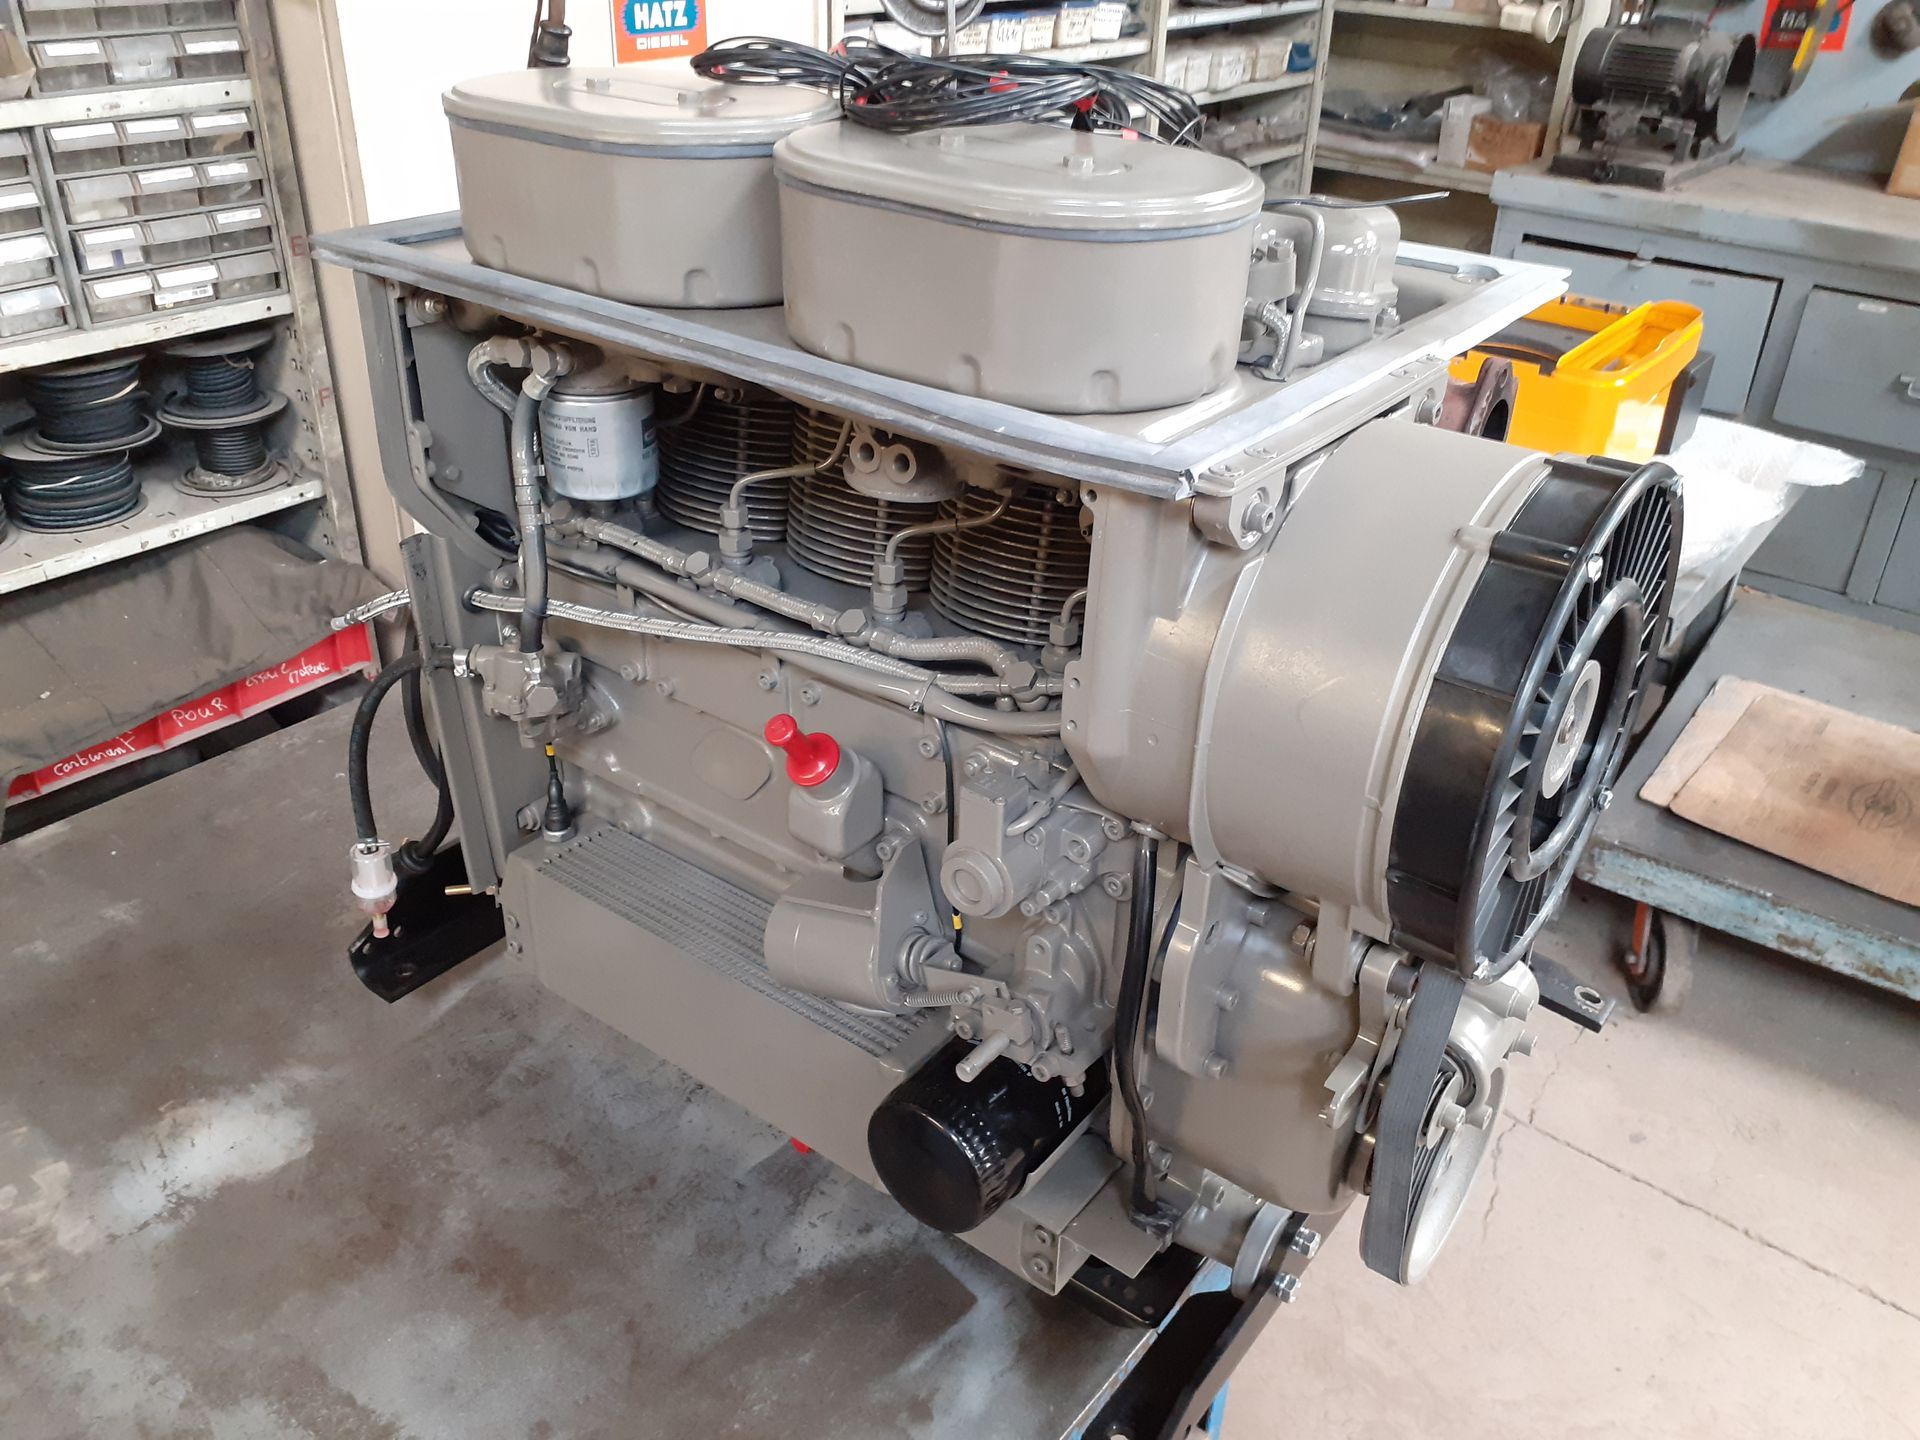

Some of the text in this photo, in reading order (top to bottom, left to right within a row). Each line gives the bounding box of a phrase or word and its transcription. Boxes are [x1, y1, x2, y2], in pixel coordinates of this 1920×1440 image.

[633, 1, 688, 30] HATZ
[636, 34, 689, 50] DIESEL
[291, 235, 306, 257] E
[318, 387, 331, 408] F
